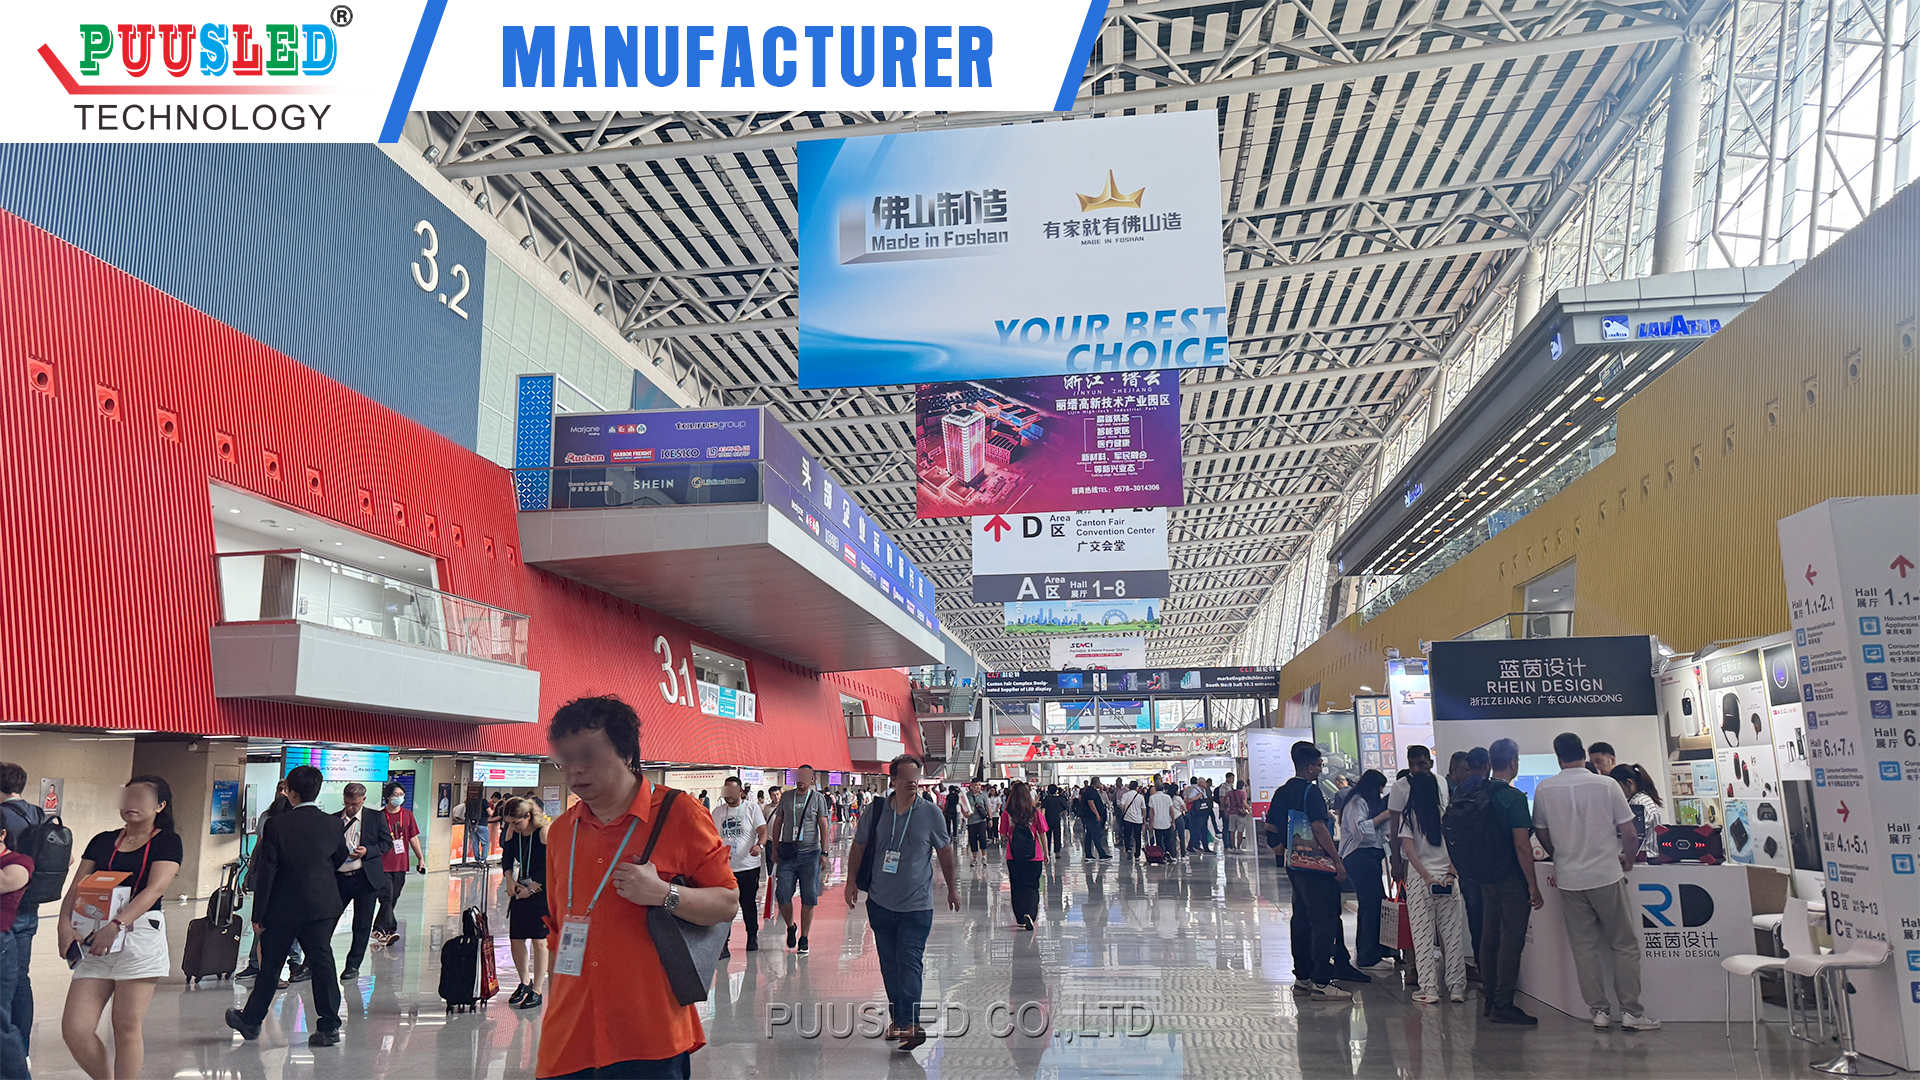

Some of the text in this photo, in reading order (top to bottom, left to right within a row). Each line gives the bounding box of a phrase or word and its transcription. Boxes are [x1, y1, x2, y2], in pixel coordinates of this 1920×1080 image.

[871, 188, 1008, 231] 佛山制造
[1042, 212, 1182, 239] 有家就有佛山造
[871, 229, 1009, 251] Made in Foshan
[411, 219, 470, 320] 3.2
[994, 306, 1227, 348] YOUR BEST
[1065, 336, 1228, 374] CHOICE
[570, 426, 600, 434] Marjane
[565, 452, 605, 463] Auchan
[661, 447, 700, 459] KESKO
[633, 479, 674, 490] SHEIN
[1114, 484, 1160, 493] 0578-3014306
[1050, 514, 1071, 522] Area
[1076, 517, 1125, 526] Canton Fair
[1022, 516, 1042, 538] D
[1051, 523, 1065, 537] 区
[1076, 526, 1156, 537] Convention Center
[1077, 540, 1126, 552] 广交会堂
[1044, 575, 1065, 584] Area
[1070, 580, 1088, 589] Hall
[1016, 576, 1039, 600] A
[1045, 585, 1060, 599] 区
[1092, 579, 1126, 598] 1-8
[1855, 588, 1877, 597] Hall
[1070, 590, 1088, 599] 展厅
[1792, 599, 1803, 609] Hall
[1857, 599, 1878, 608] 展厅
[654, 635, 694, 708] 3.1
[1499, 657, 1587, 678] 蓝茵设计
[1487, 678, 1603, 694] RHEIN DESIGN
[1874, 728, 1896, 737] Hall
[1811, 739, 1822, 747] Hall
[1876, 739, 1898, 748] 展厅
[1887, 823, 1910, 832] Hall
[1823, 832, 1834, 841] Hall
[1889, 834, 1912, 844] 展厅
[1831, 891, 1840, 908] B
[1842, 899, 1848, 910] 区
[1860, 900, 1878, 915] 9-13
[1835, 919, 1844, 937] C
[1846, 927, 1852, 939] 区
[1644, 931, 1718, 949] 蓝茵设计
[1645, 950, 1720, 958] RHEIN DESIGN
